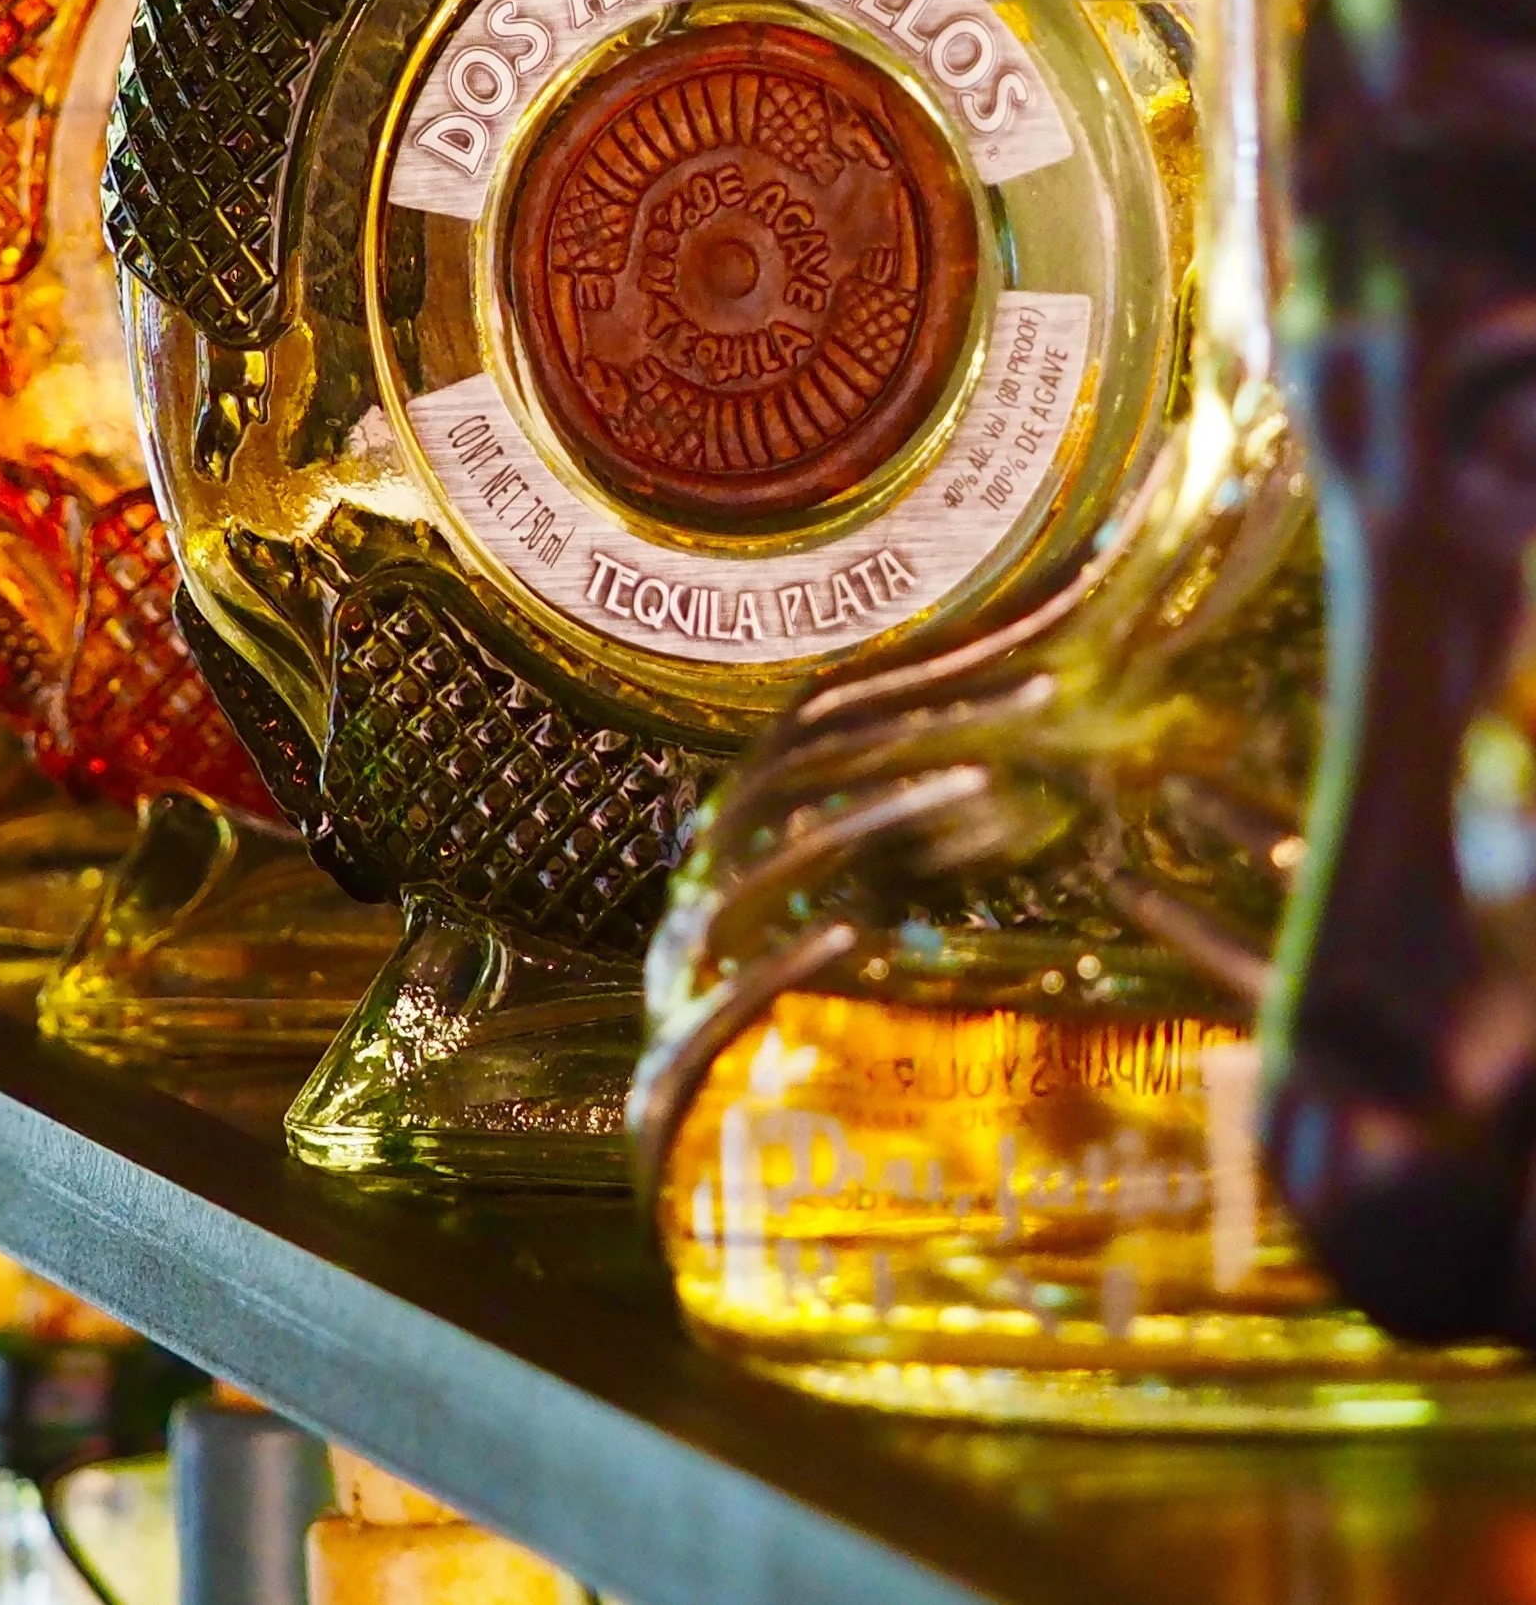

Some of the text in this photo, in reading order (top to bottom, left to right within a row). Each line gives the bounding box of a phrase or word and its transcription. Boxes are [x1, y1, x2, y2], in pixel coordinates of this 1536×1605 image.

[415, 0, 552, 175] DOS
[689, 162, 747, 217] DE
[746, 181, 832, 314] AGAVE
[644, 295, 814, 384] TEQUILA
[943, 470, 980, 510] 40%
[1006, 305, 1047, 377] PROOF)
[447, 415, 505, 480] CONT.
[478, 463, 530, 521] NET.
[979, 344, 1069, 511] 100% DE AGAVE
[585, 547, 920, 641] TEQUILA PLATA
